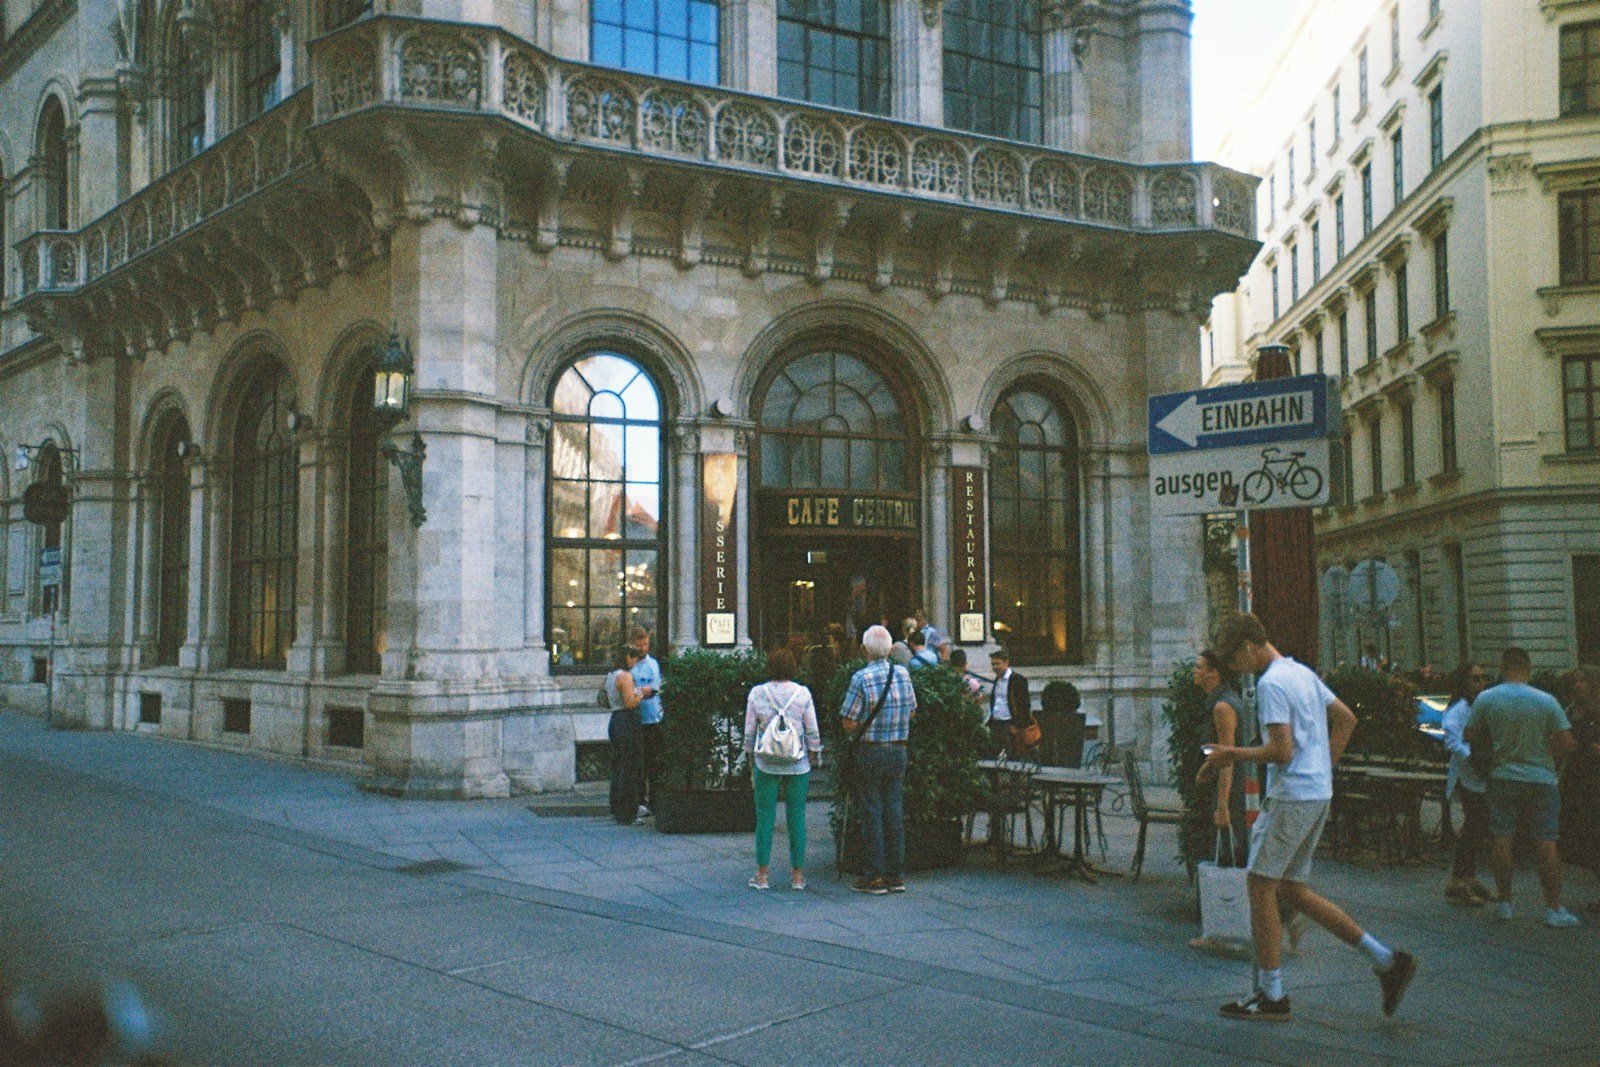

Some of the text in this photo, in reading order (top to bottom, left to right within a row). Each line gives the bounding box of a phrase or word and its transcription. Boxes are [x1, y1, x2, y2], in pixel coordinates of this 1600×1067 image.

[1202, 396, 1303, 432] EINBAHN
[787, 498, 839, 525] CAFE
[965, 472, 975, 610] RESTAURANT
